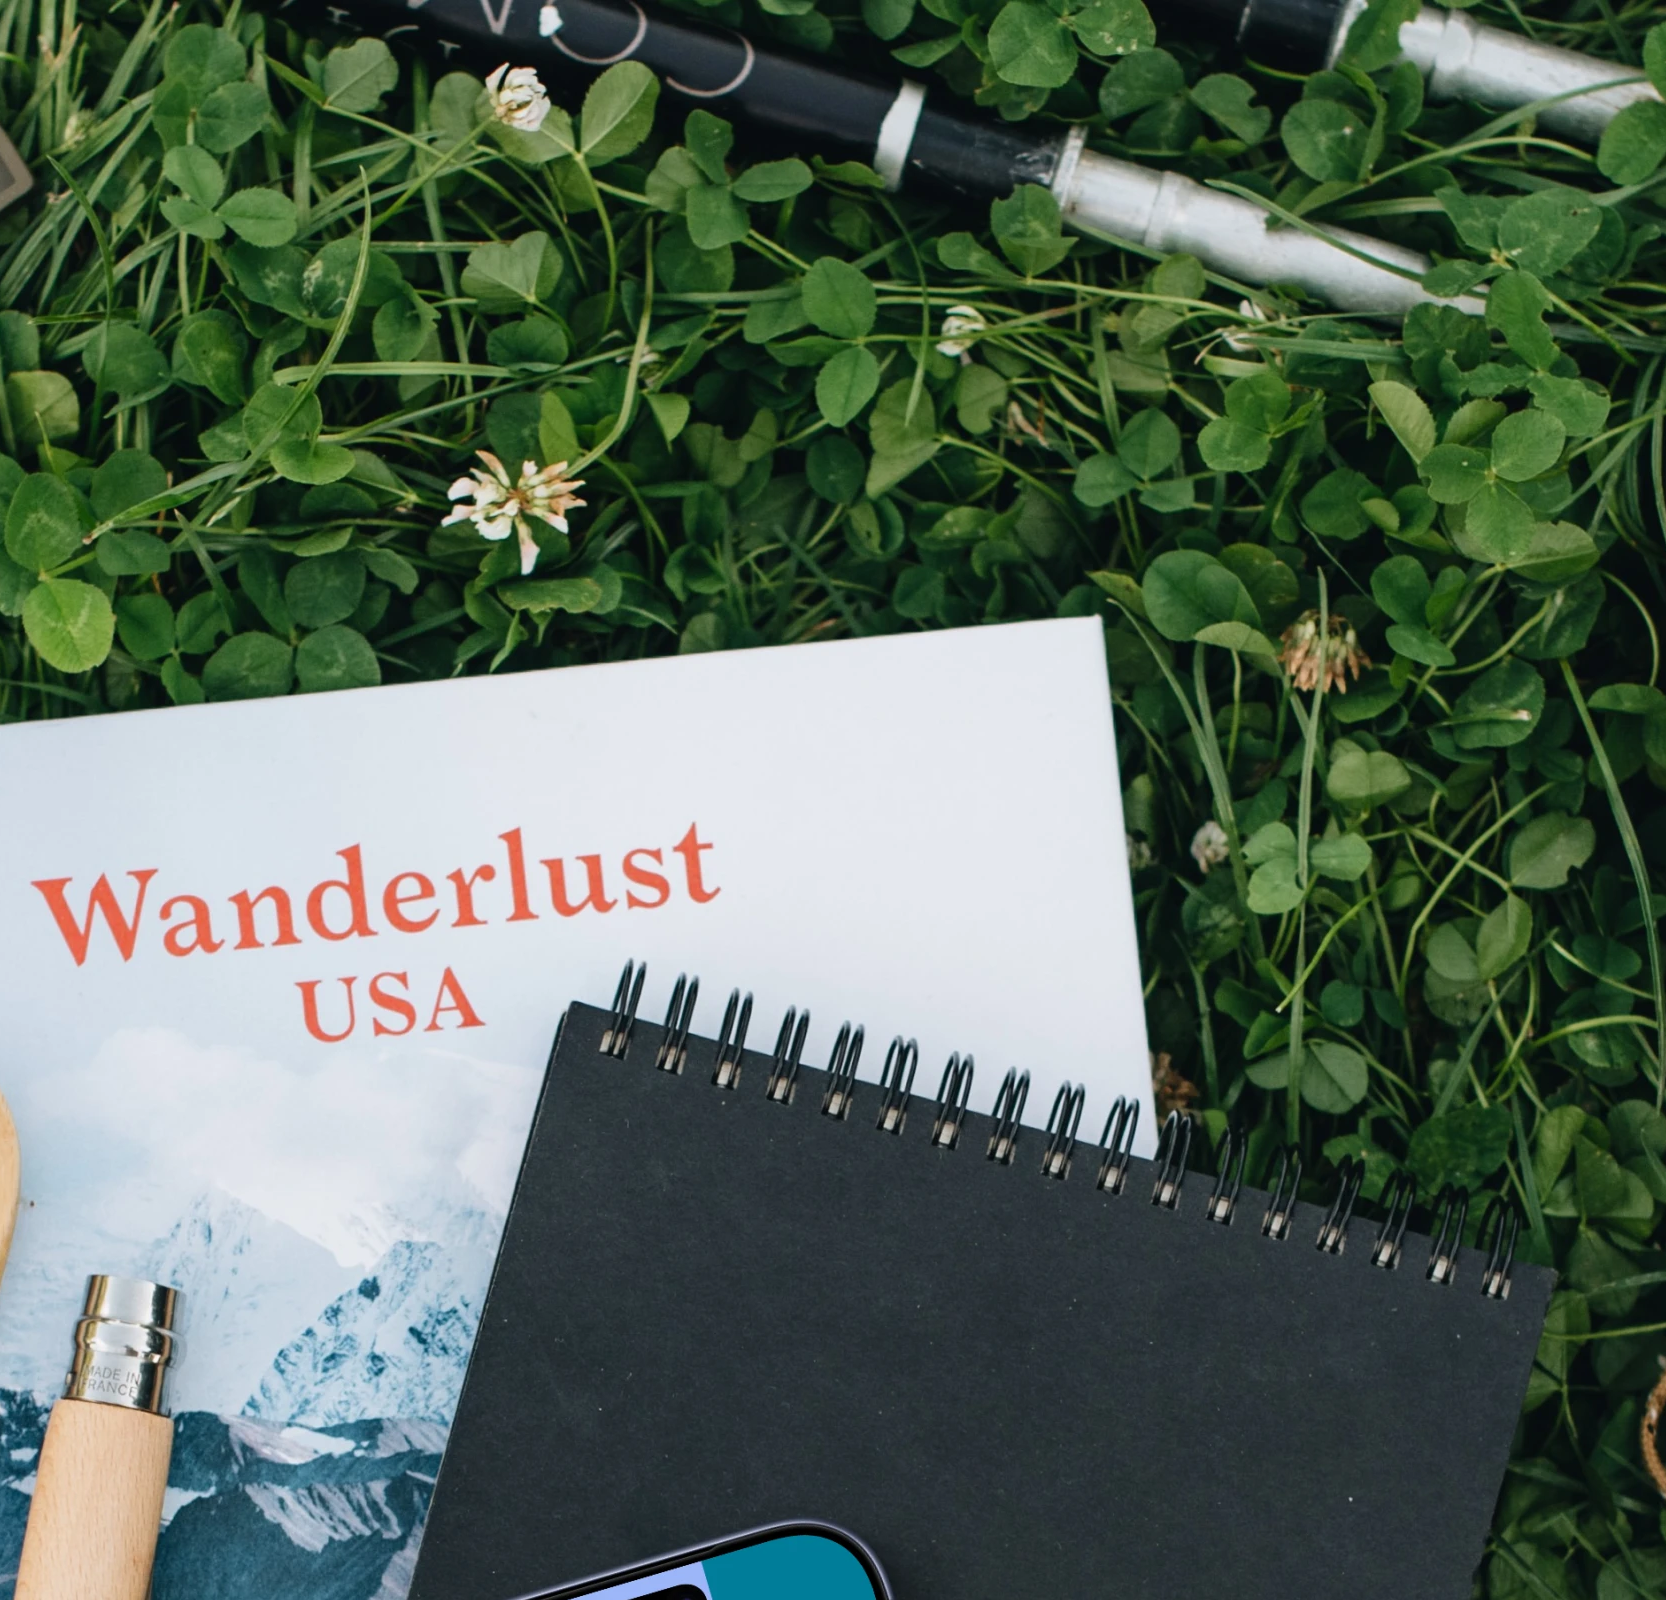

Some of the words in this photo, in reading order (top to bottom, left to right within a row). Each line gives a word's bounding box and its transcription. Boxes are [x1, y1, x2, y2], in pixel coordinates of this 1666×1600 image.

[31, 822, 721, 967] Wanderlust
[294, 966, 486, 1044] USA
[83, 1377, 138, 1399] FRANCE
[85, 1365, 121, 1381] MADE
[126, 1371, 141, 1387] IN
